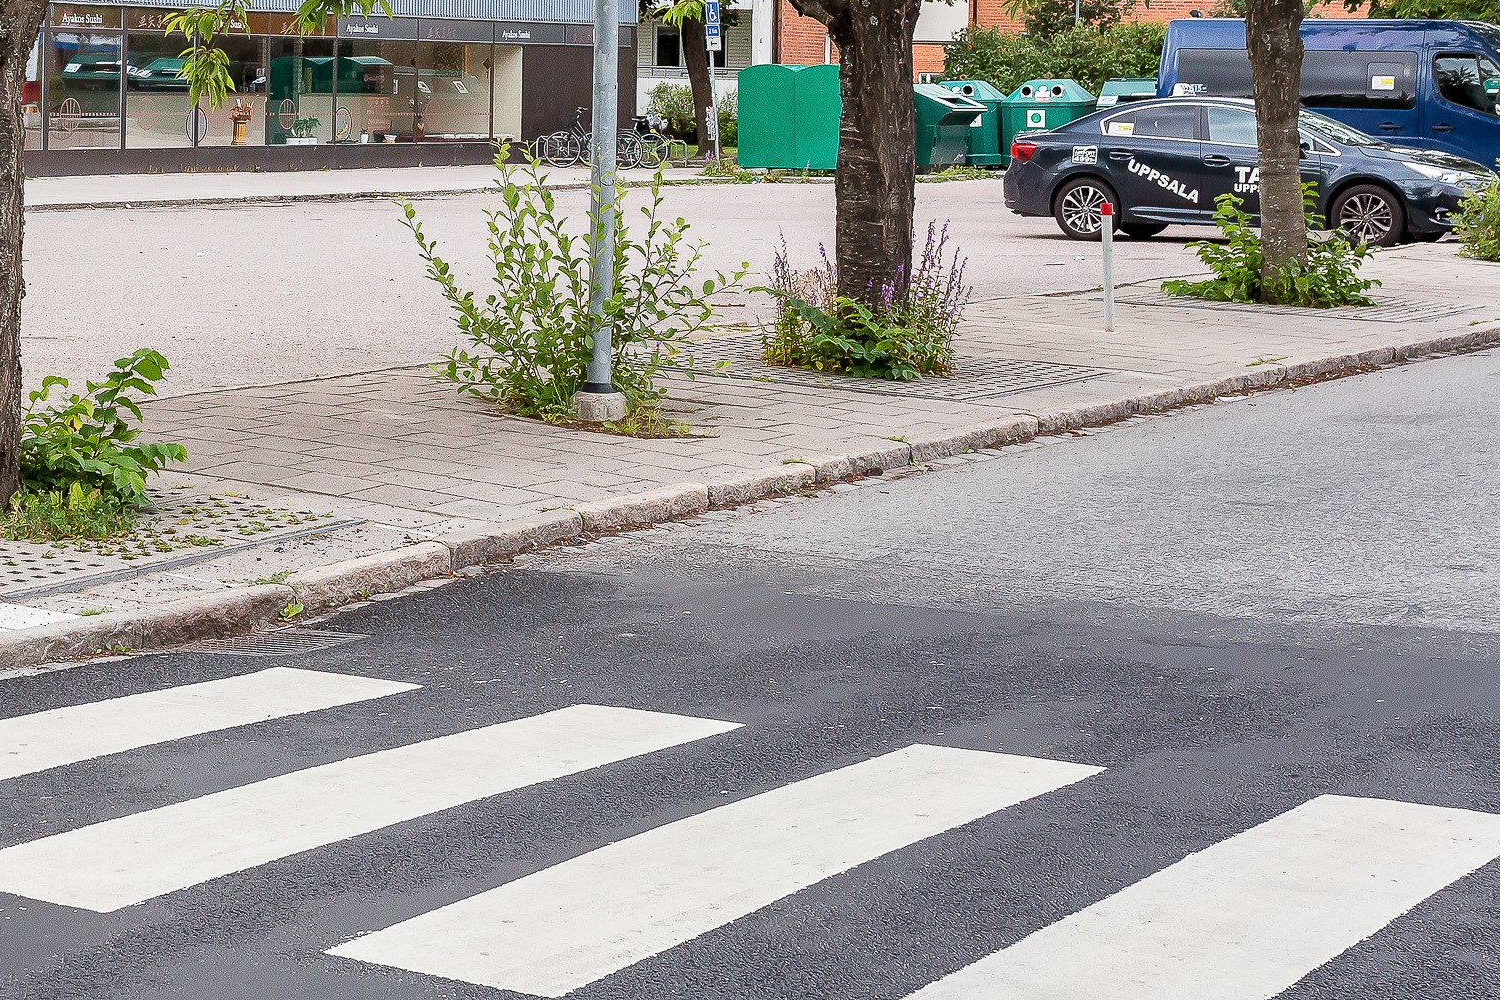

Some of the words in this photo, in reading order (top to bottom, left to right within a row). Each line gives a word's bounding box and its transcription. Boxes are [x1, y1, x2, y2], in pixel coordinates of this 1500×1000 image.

[62, 12, 85, 26] Ayakos
[85, 14, 103, 24] Sushi
[1127, 158, 1199, 204] UPPSALA
[1235, 166, 1260, 183] TA
